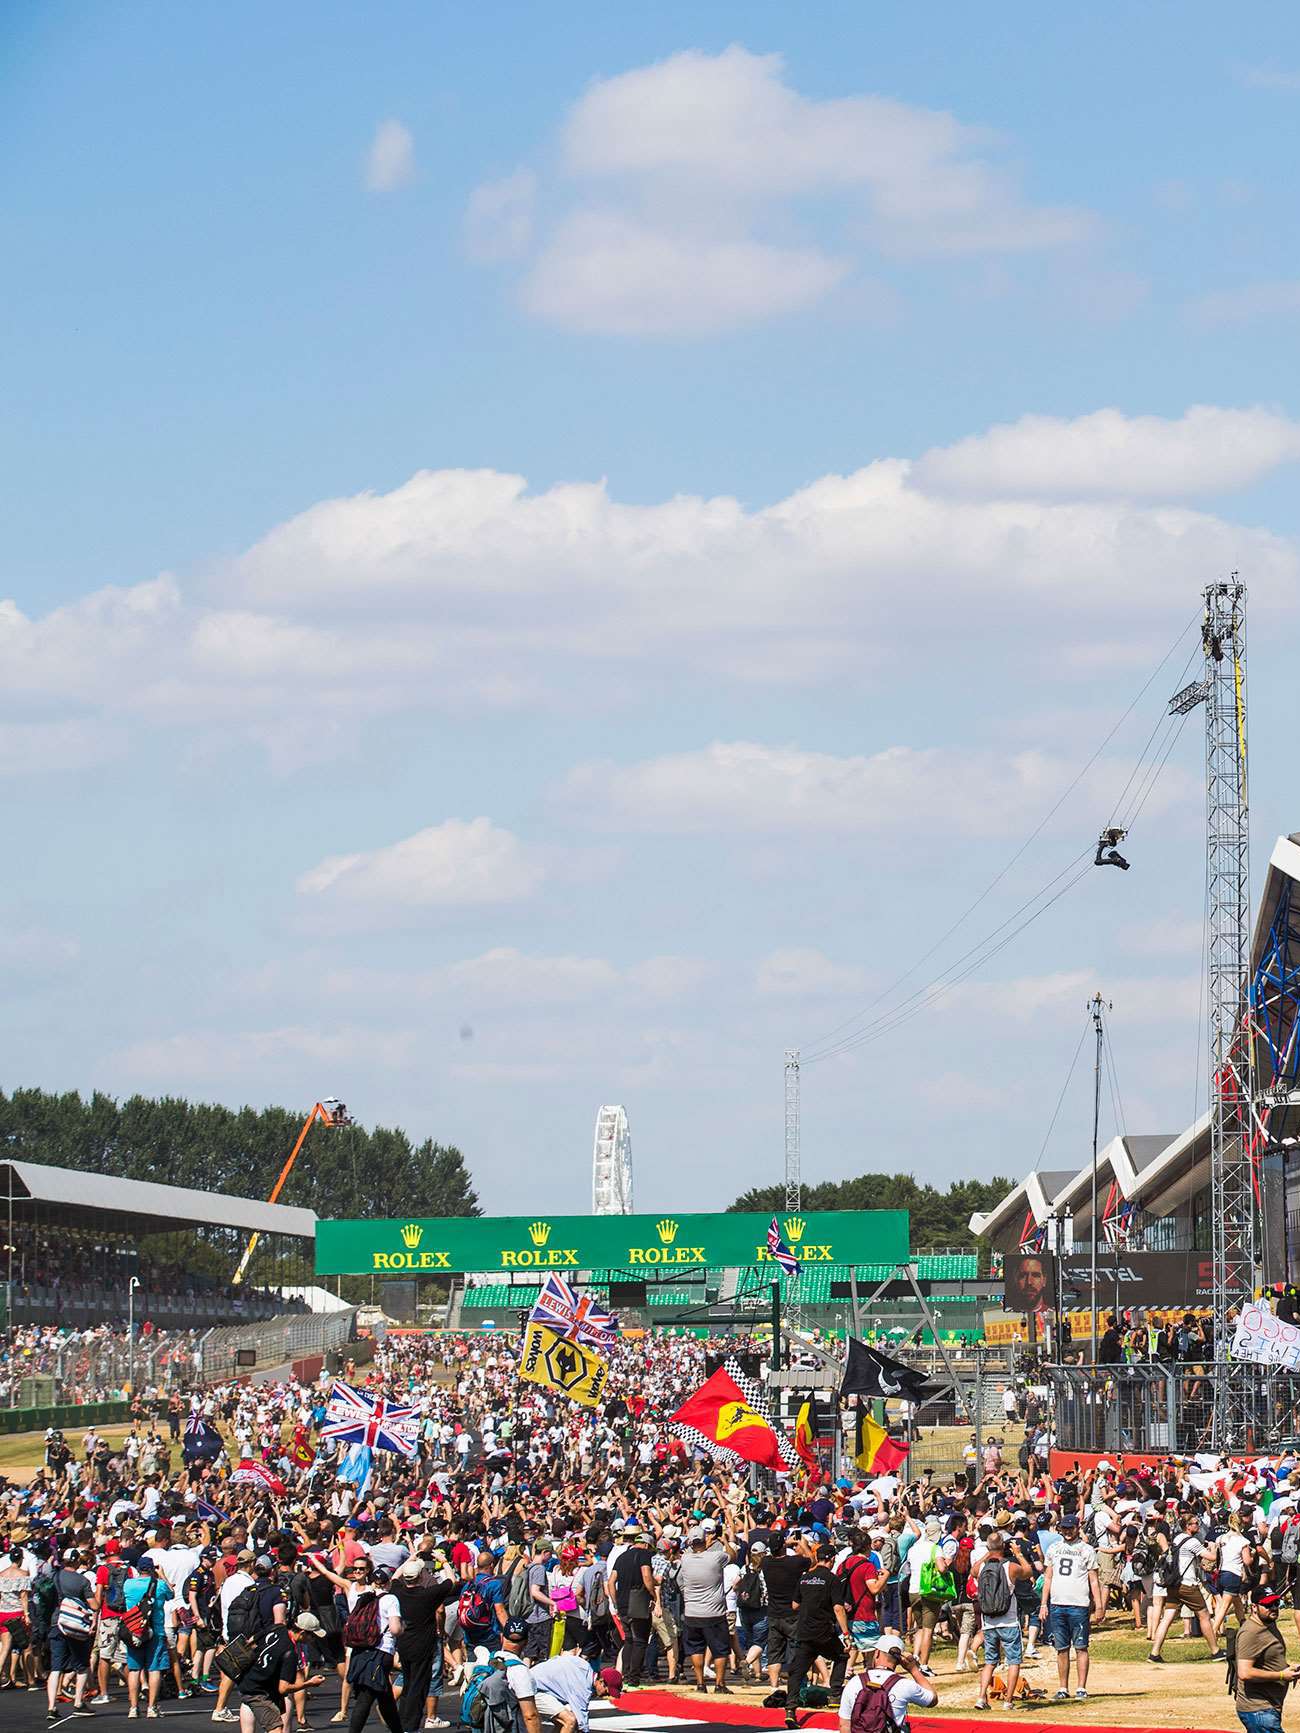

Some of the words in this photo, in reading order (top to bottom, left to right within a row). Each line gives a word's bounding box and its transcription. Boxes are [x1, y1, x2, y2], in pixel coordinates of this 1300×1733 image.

[373, 1252, 452, 1268] ROLEX
[501, 1249, 580, 1266] ROLEX
[628, 1247, 707, 1264] ROLEX
[756, 1245, 834, 1261] RLEX
[543, 1296, 575, 1320] LEWIS
[328, 1405, 370, 1422] LEWIS
[1058, 1557, 1074, 1577] 8
